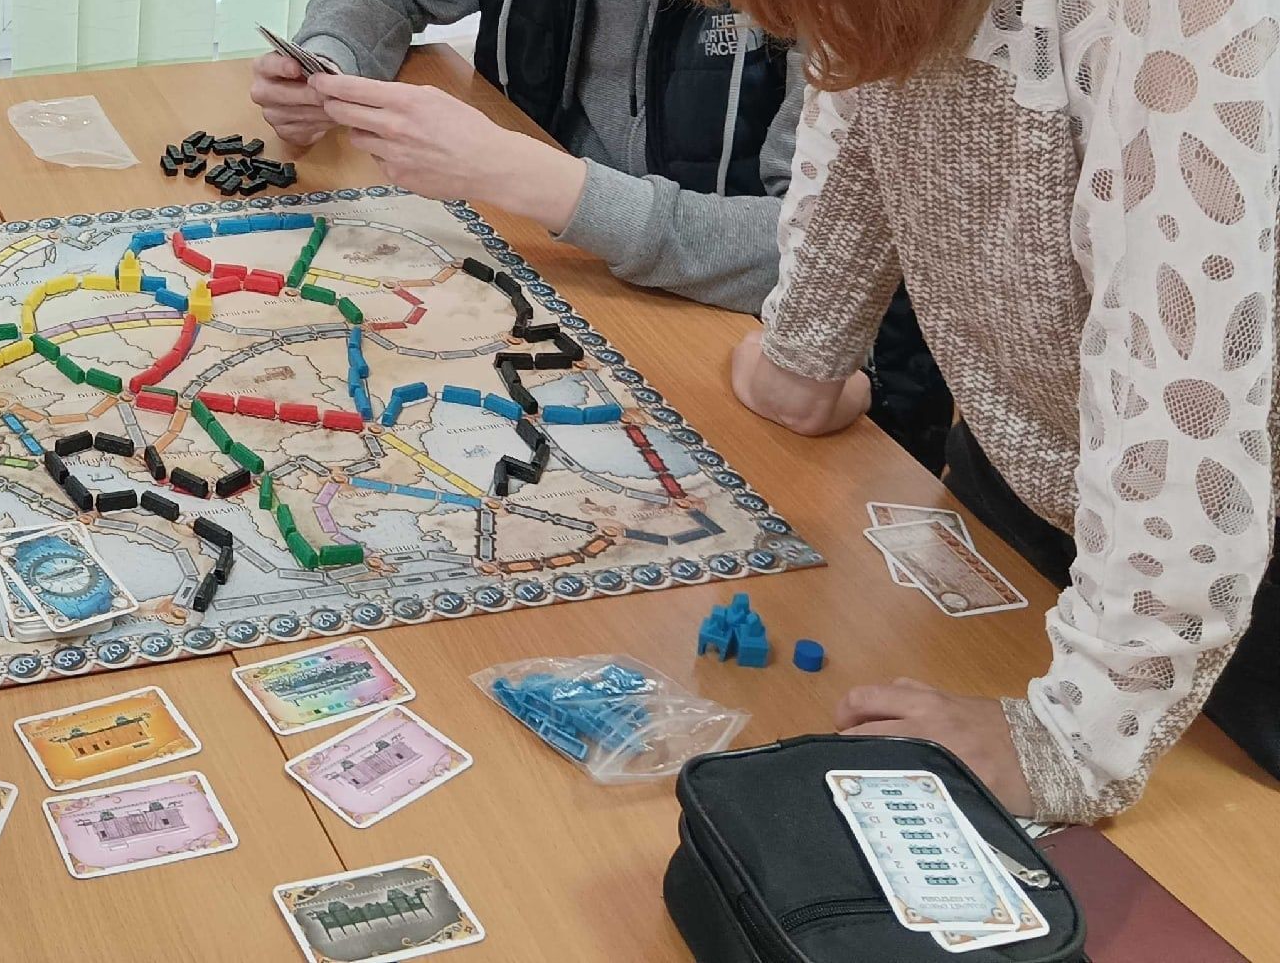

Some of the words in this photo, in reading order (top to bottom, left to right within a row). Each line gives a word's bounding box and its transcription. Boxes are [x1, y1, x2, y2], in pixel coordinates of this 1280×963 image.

[712, 14, 735, 28] THE
[705, 42, 738, 56] FACE
[696, 451, 718, 464] 66
[718, 474, 740, 485] 67
[737, 496, 763, 510] 68
[761, 520, 786, 533] 69
[15, 657, 37, 674] 89
[57, 650, 81, 667] 88
[103, 643, 126, 660] 87
[145, 637, 167, 653] 86
[232, 624, 254, 639] 84
[274, 618, 296, 633] 83
[319, 612, 339, 628] 82
[360, 606, 378, 620] 81
[440, 596, 461, 611] 79
[481, 590, 501, 605] 78
[520, 585, 542, 600] 77
[561, 579, 581, 593] 76
[679, 563, 697, 577] 73
[716, 558, 735, 572] 72
[755, 552, 773, 566] 71
